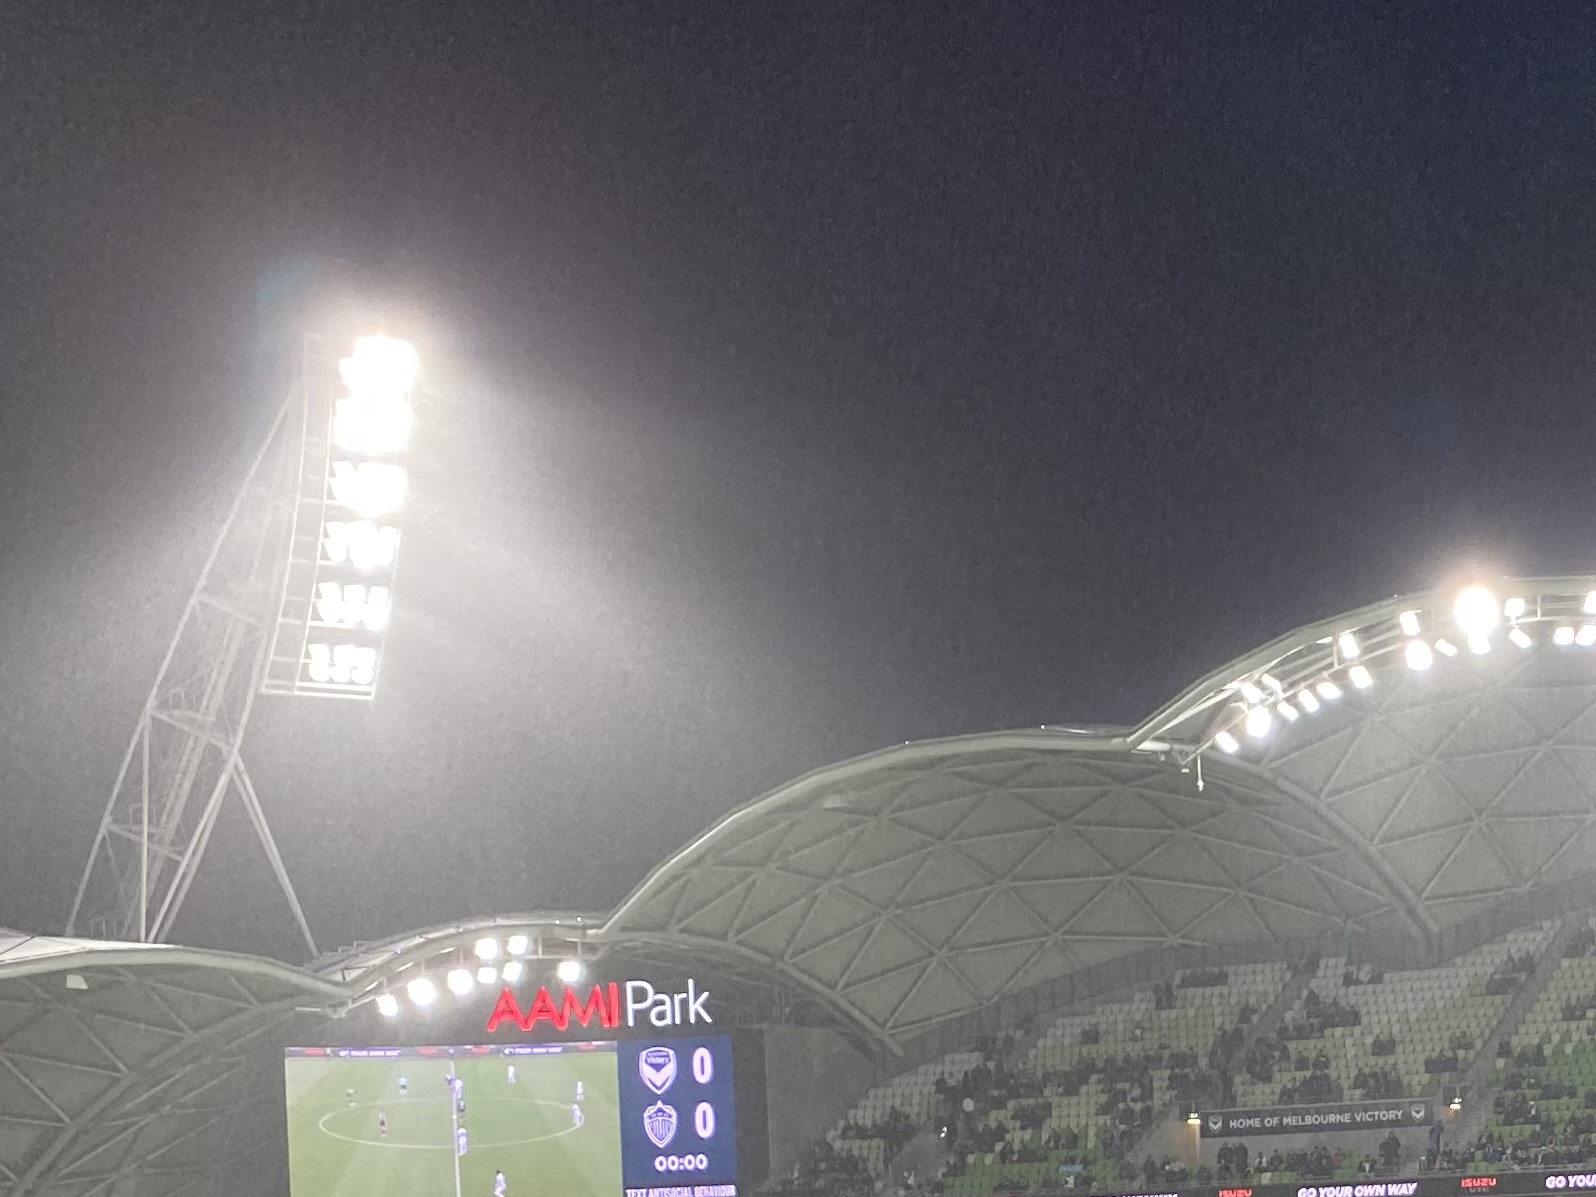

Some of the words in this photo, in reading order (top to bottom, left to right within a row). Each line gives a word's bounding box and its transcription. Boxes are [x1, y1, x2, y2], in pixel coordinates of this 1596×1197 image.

[487, 982, 619, 1033] AAMI
[625, 978, 713, 1028] Park
[692, 1047, 714, 1085] 0
[694, 1101, 716, 1139] 0
[1229, 1119, 1262, 1130] HOME
[1264, 1117, 1279, 1128] OF
[1282, 1113, 1352, 1126] MELBOURNE
[1354, 1110, 1403, 1122] VICTORY
[654, 1153, 709, 1172] 00:00
[694, 1184, 736, 1197] BEHAVIOUR
[1354, 1184, 1387, 1197] OWN
[1387, 1182, 1418, 1196] WAY
[1461, 1177, 1497, 1188] ISUZU
[1545, 1176, 1566, 1189] GO
